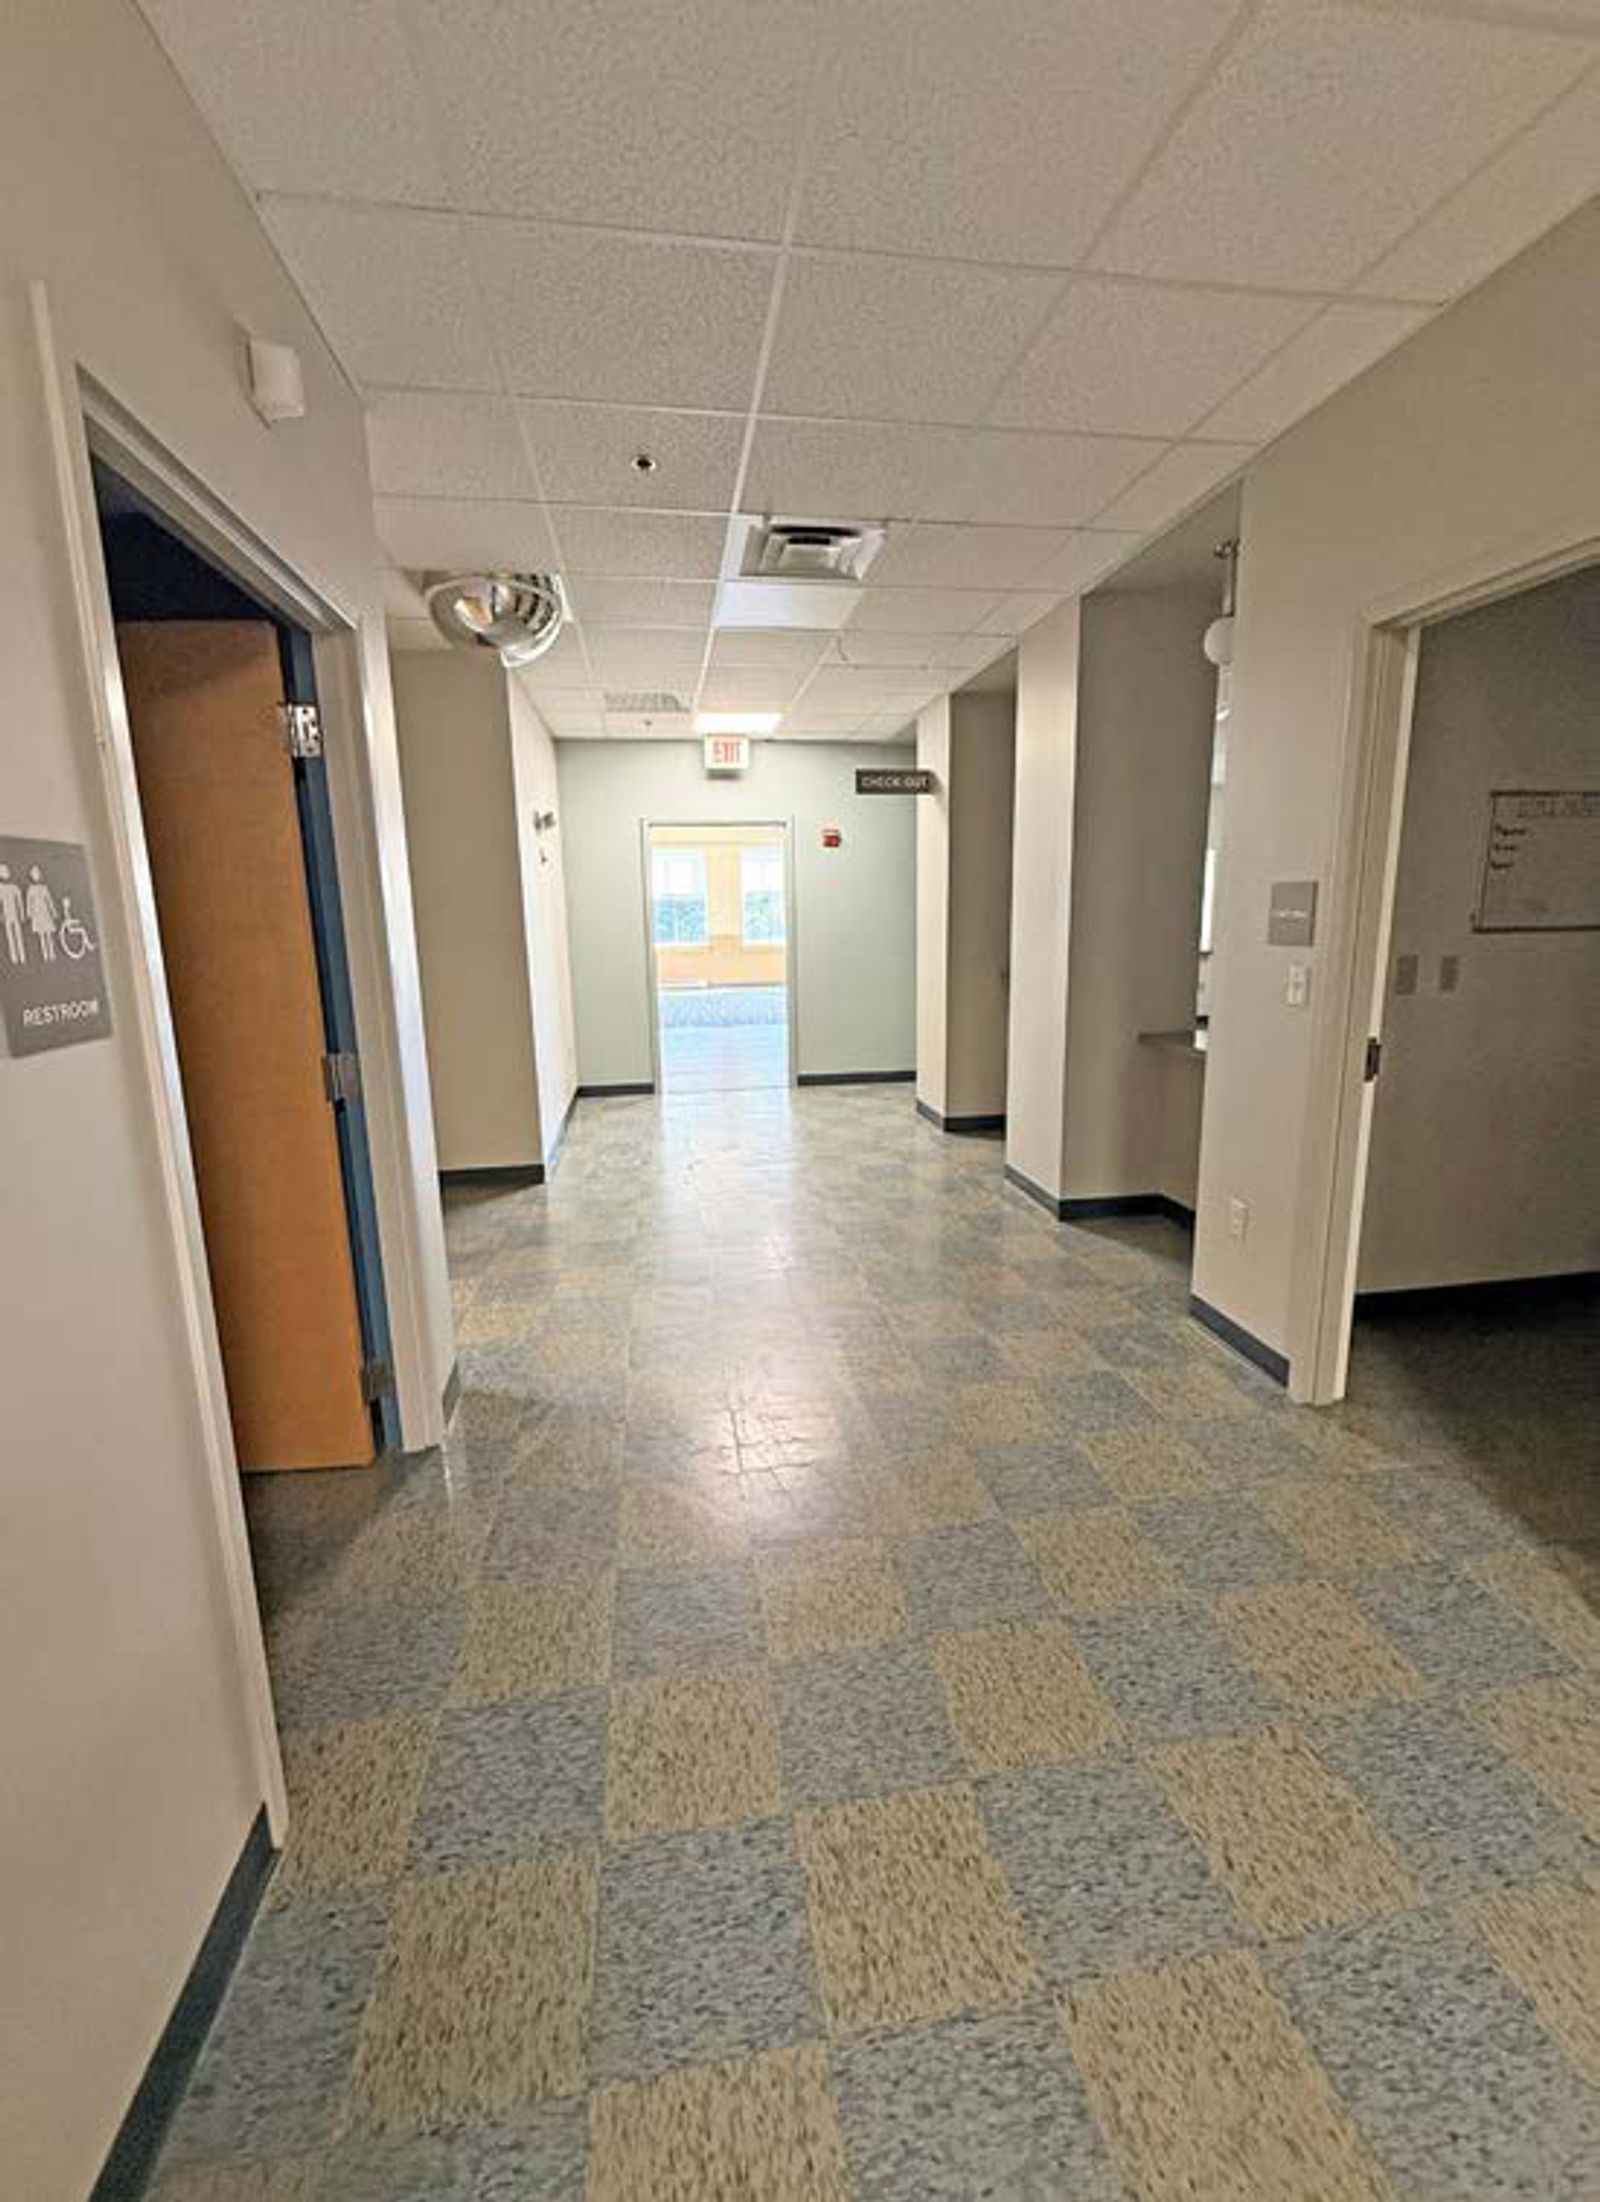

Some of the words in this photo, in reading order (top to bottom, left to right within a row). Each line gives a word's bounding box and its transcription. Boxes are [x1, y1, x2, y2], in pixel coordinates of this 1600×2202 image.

[713, 741, 742, 763] EXIT
[861, 775, 900, 788] CHECK
[904, 775, 928, 788] OUT
[23, 998, 98, 1027] RESTROOM
